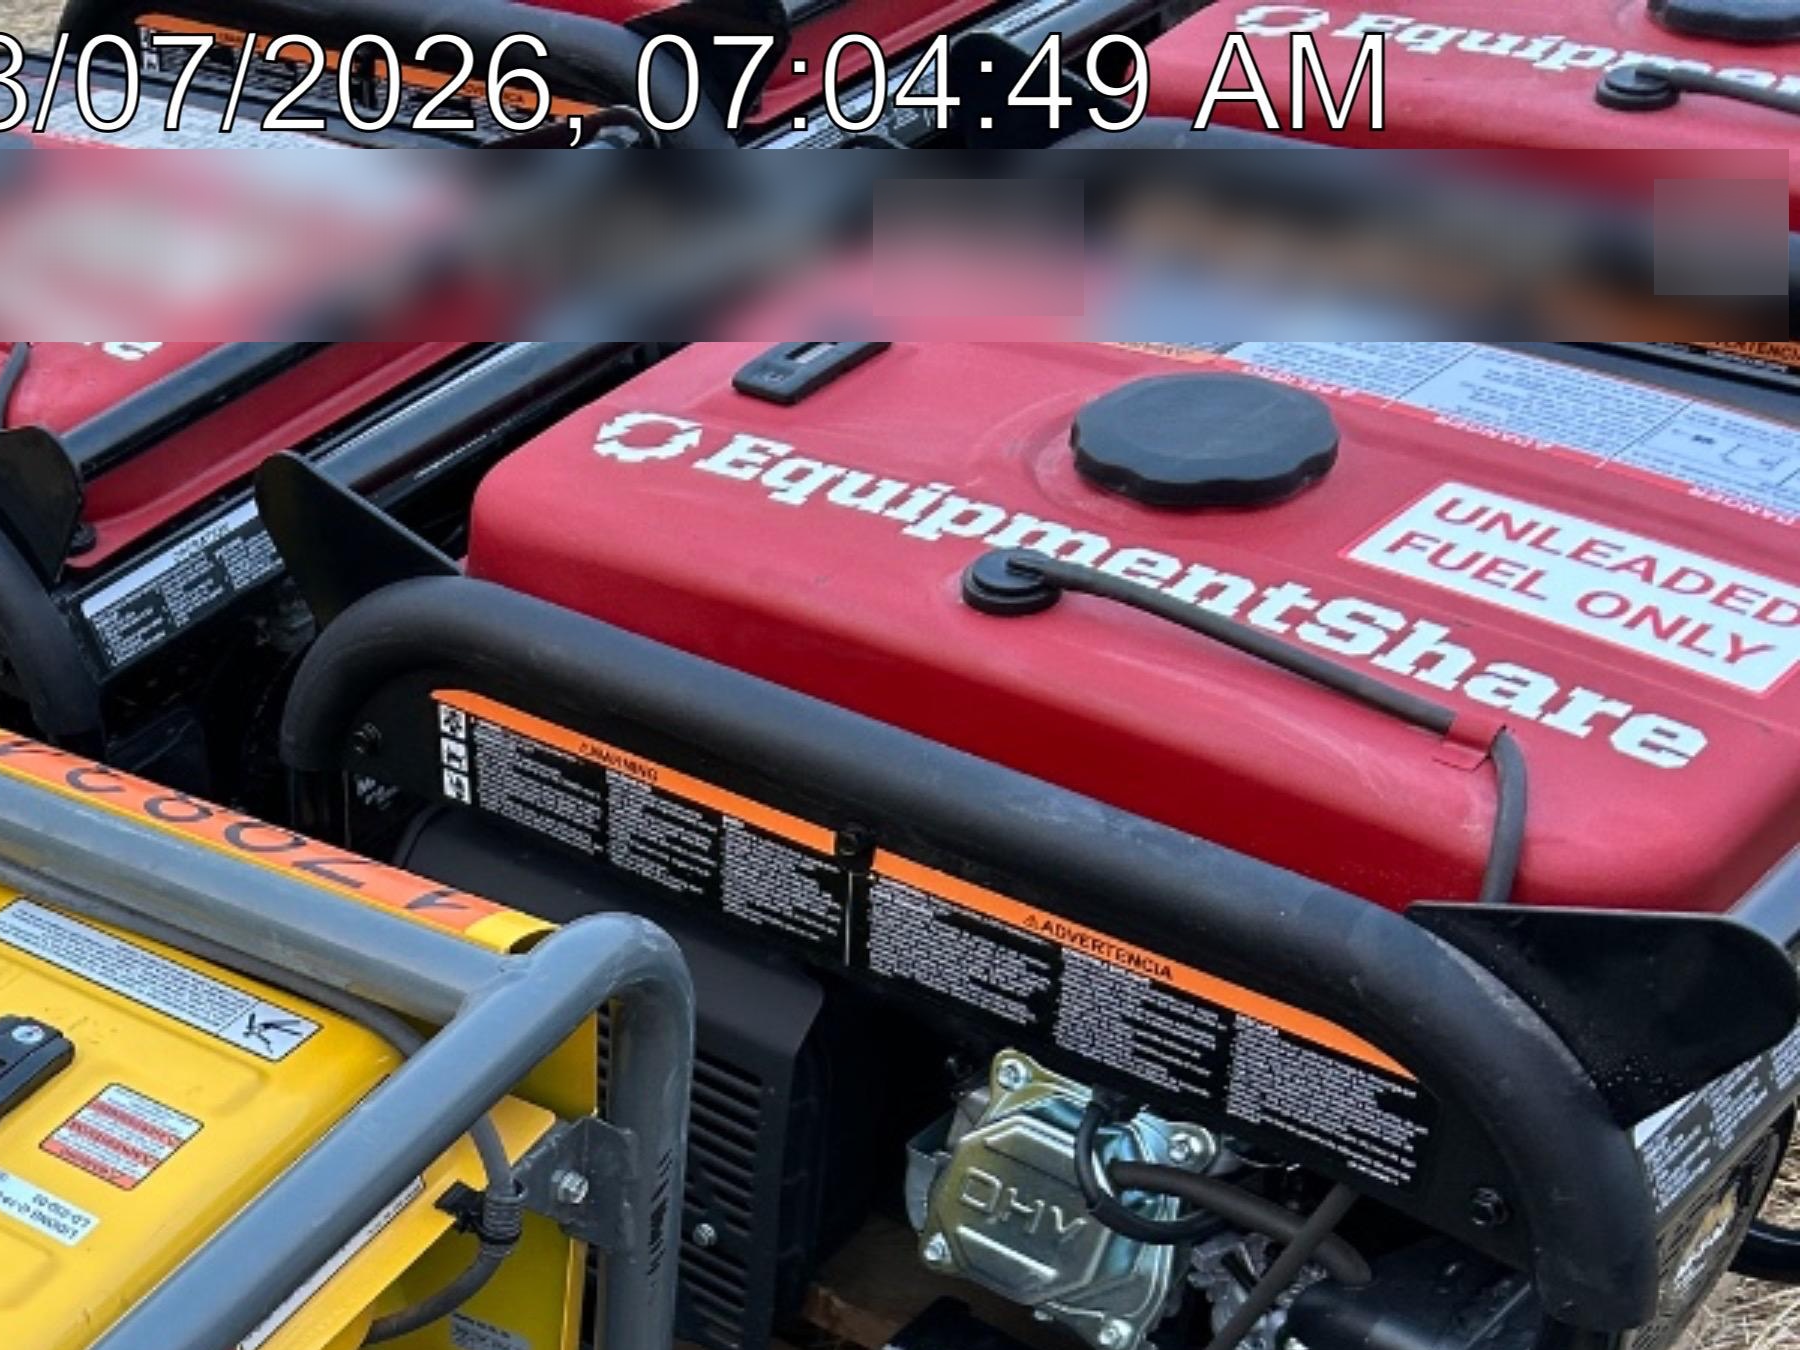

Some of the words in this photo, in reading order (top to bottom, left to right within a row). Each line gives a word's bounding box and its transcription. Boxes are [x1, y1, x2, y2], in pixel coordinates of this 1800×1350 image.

[694, 433, 1709, 769] EquipmentShare
[1384, 530, 1548, 600] FUEL
[1575, 590, 1777, 665] ONLY
[1434, 497, 1800, 627] UNLEADED
[594, 741, 660, 784] WARNING
[1040, 919, 1174, 981] ADVERTENCIA
